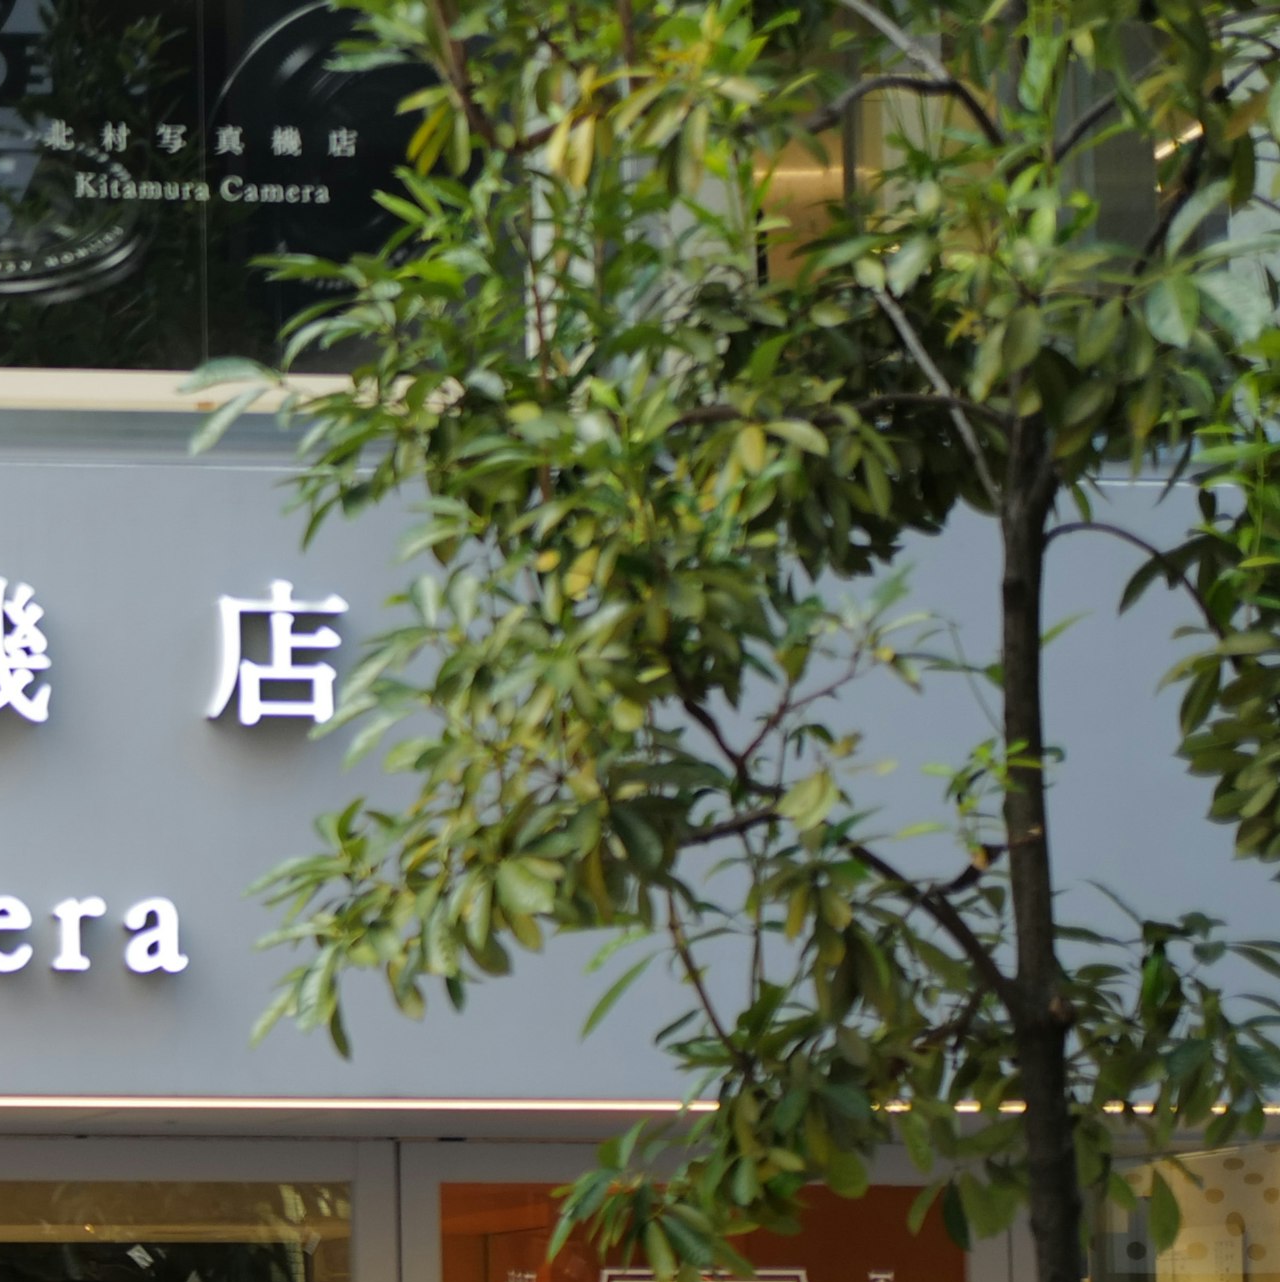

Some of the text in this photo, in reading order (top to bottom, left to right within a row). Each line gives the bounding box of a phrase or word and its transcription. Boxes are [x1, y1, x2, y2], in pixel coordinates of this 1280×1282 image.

[44, 119, 358, 158] 北村写真機店
[74, 171, 331, 204] Kitamura Camera
